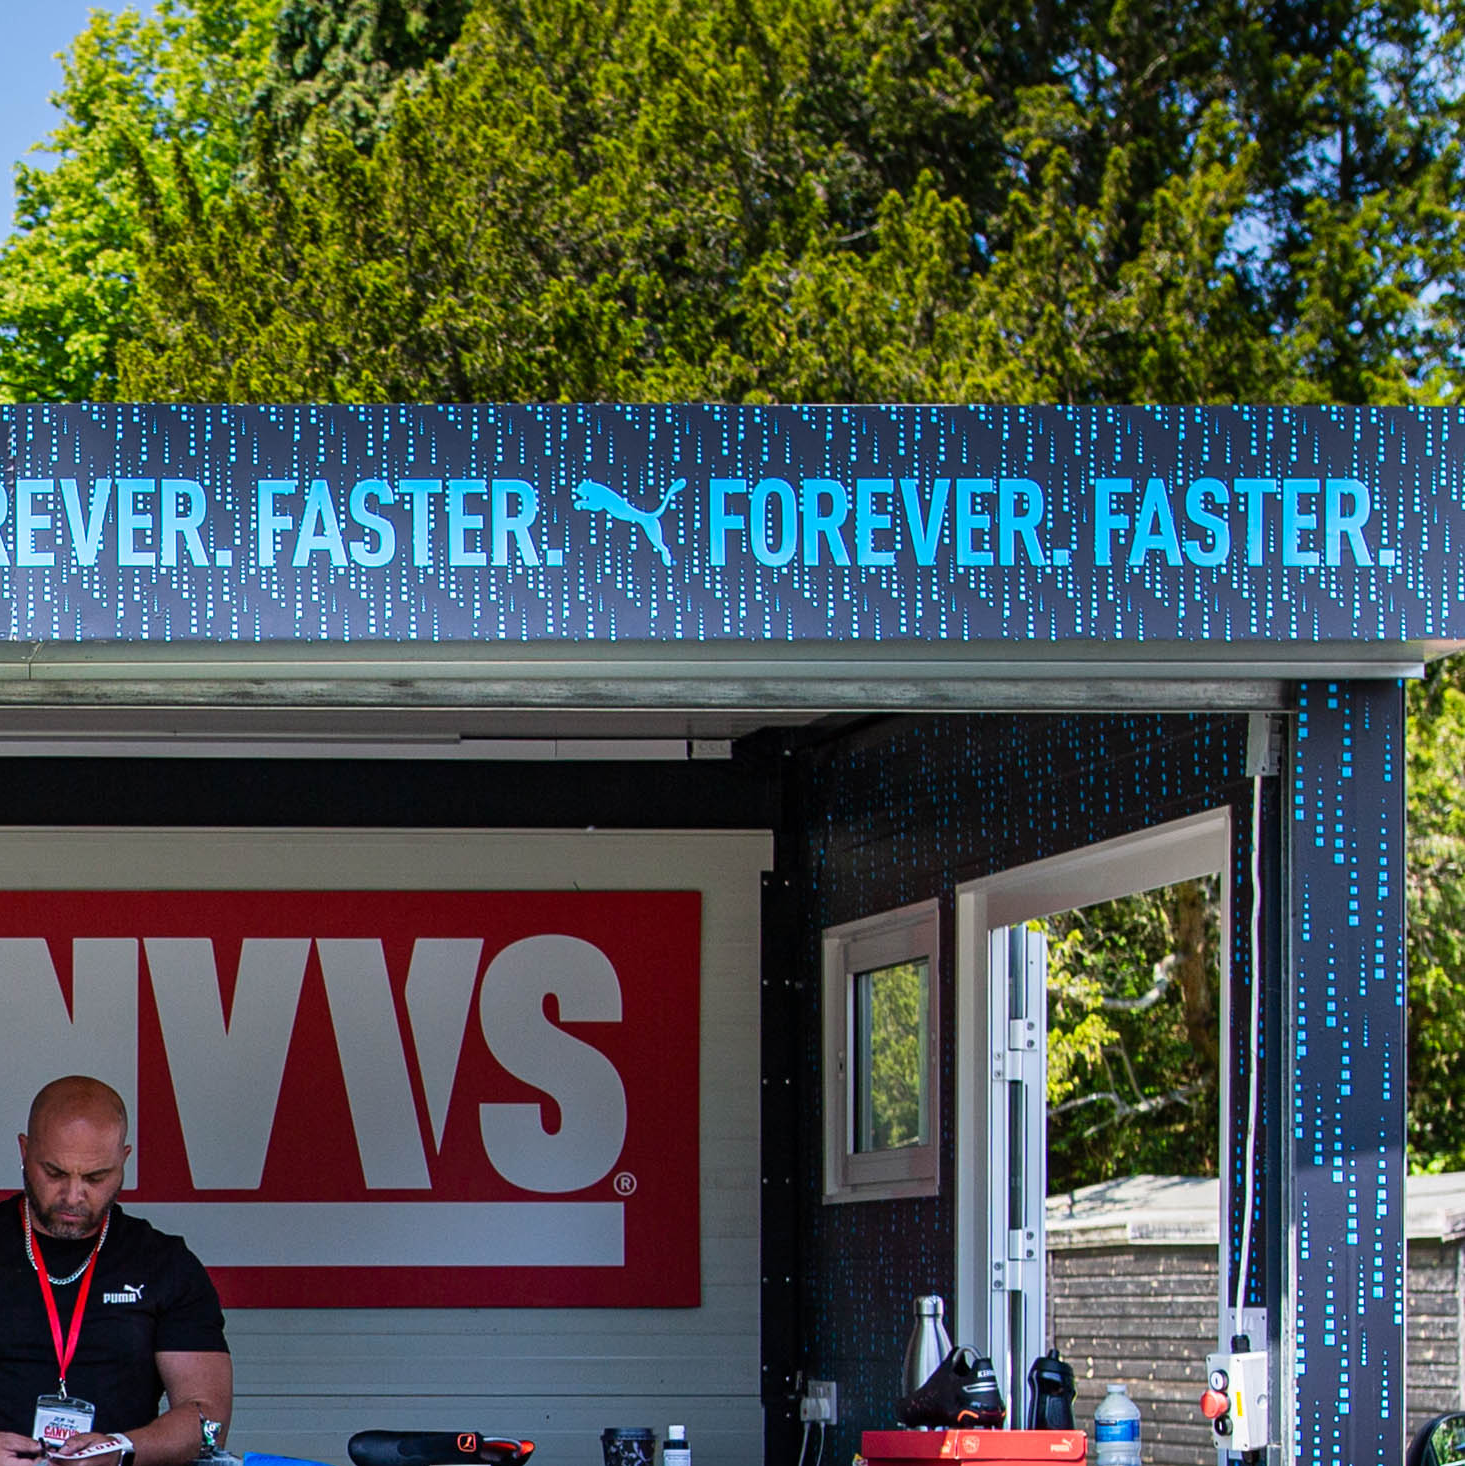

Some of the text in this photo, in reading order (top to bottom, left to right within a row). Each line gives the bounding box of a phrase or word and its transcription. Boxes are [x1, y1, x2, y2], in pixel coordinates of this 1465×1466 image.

[257, 477, 562, 568] FASTER.
[709, 477, 1396, 568] FOREVER. FASTER.
[103, 1292, 137, 1304] PUMA
